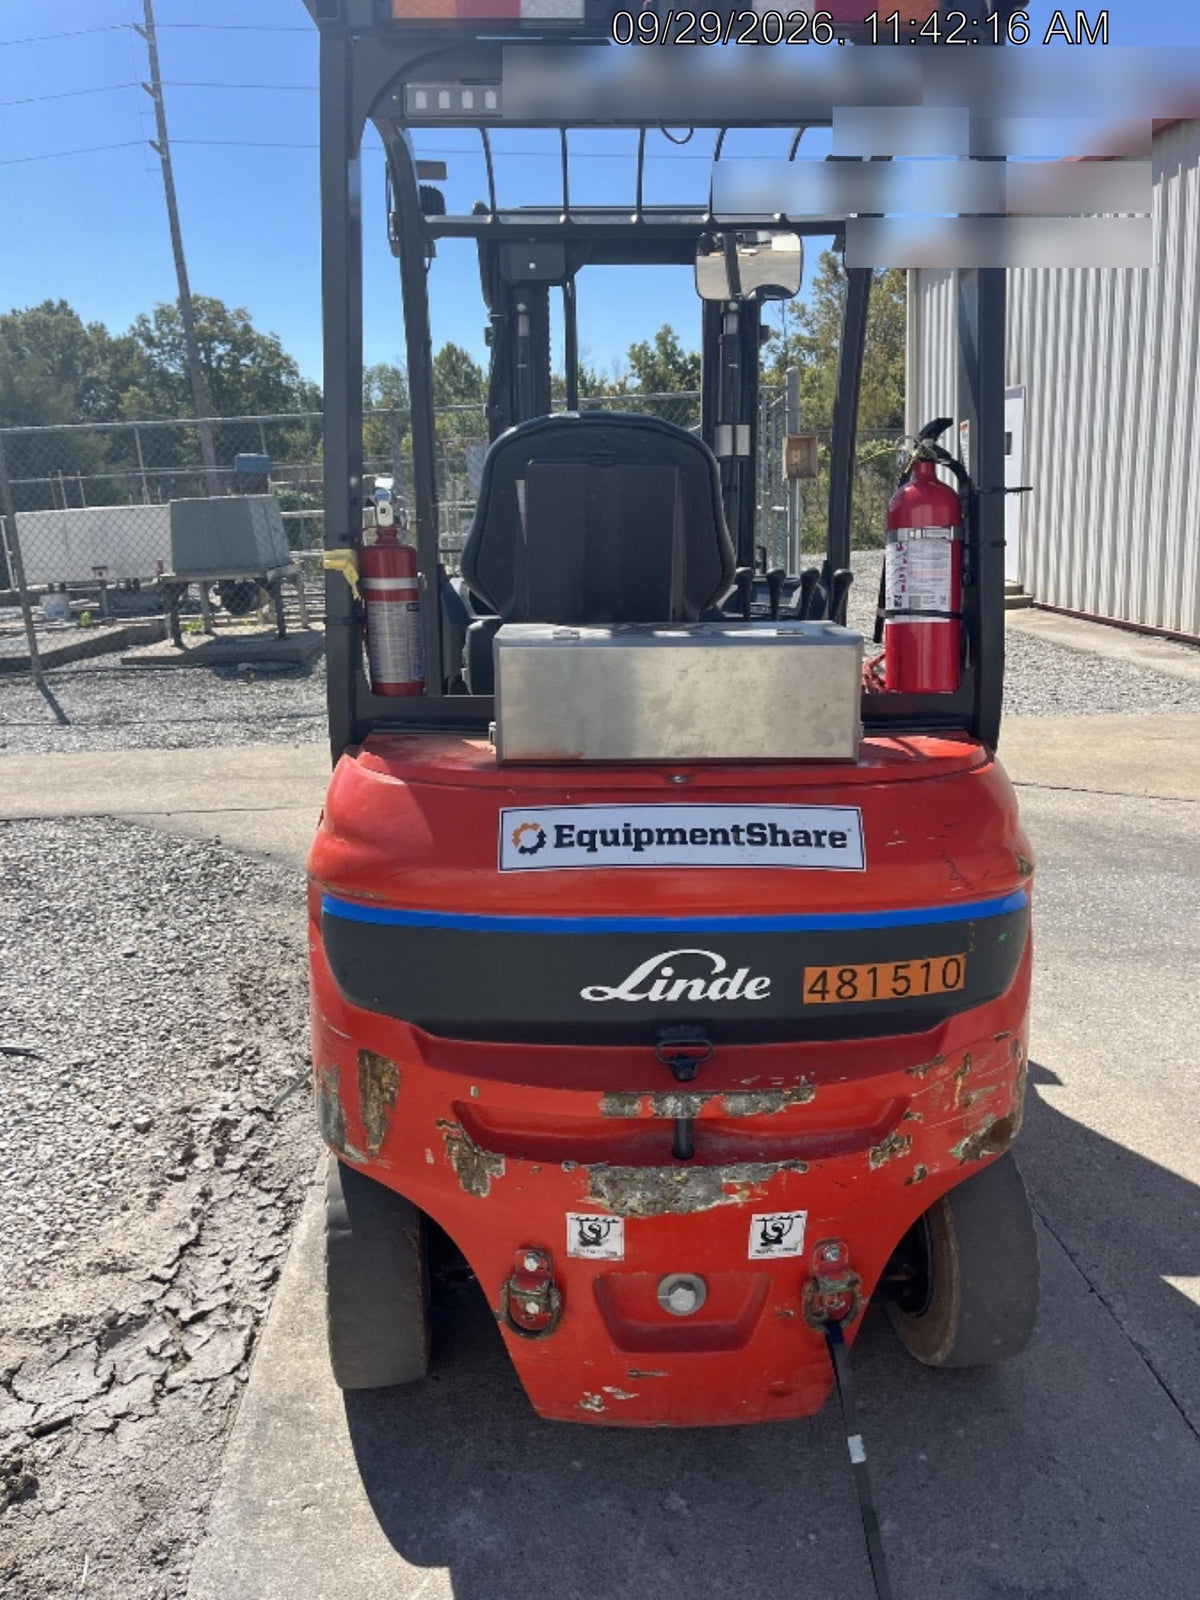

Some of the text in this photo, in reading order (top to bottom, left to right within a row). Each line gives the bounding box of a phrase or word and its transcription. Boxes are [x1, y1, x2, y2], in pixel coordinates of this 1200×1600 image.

[554, 822, 849, 852] EquipmentShare
[580, 949, 771, 1001] Linde
[807, 957, 962, 1001] 481510
